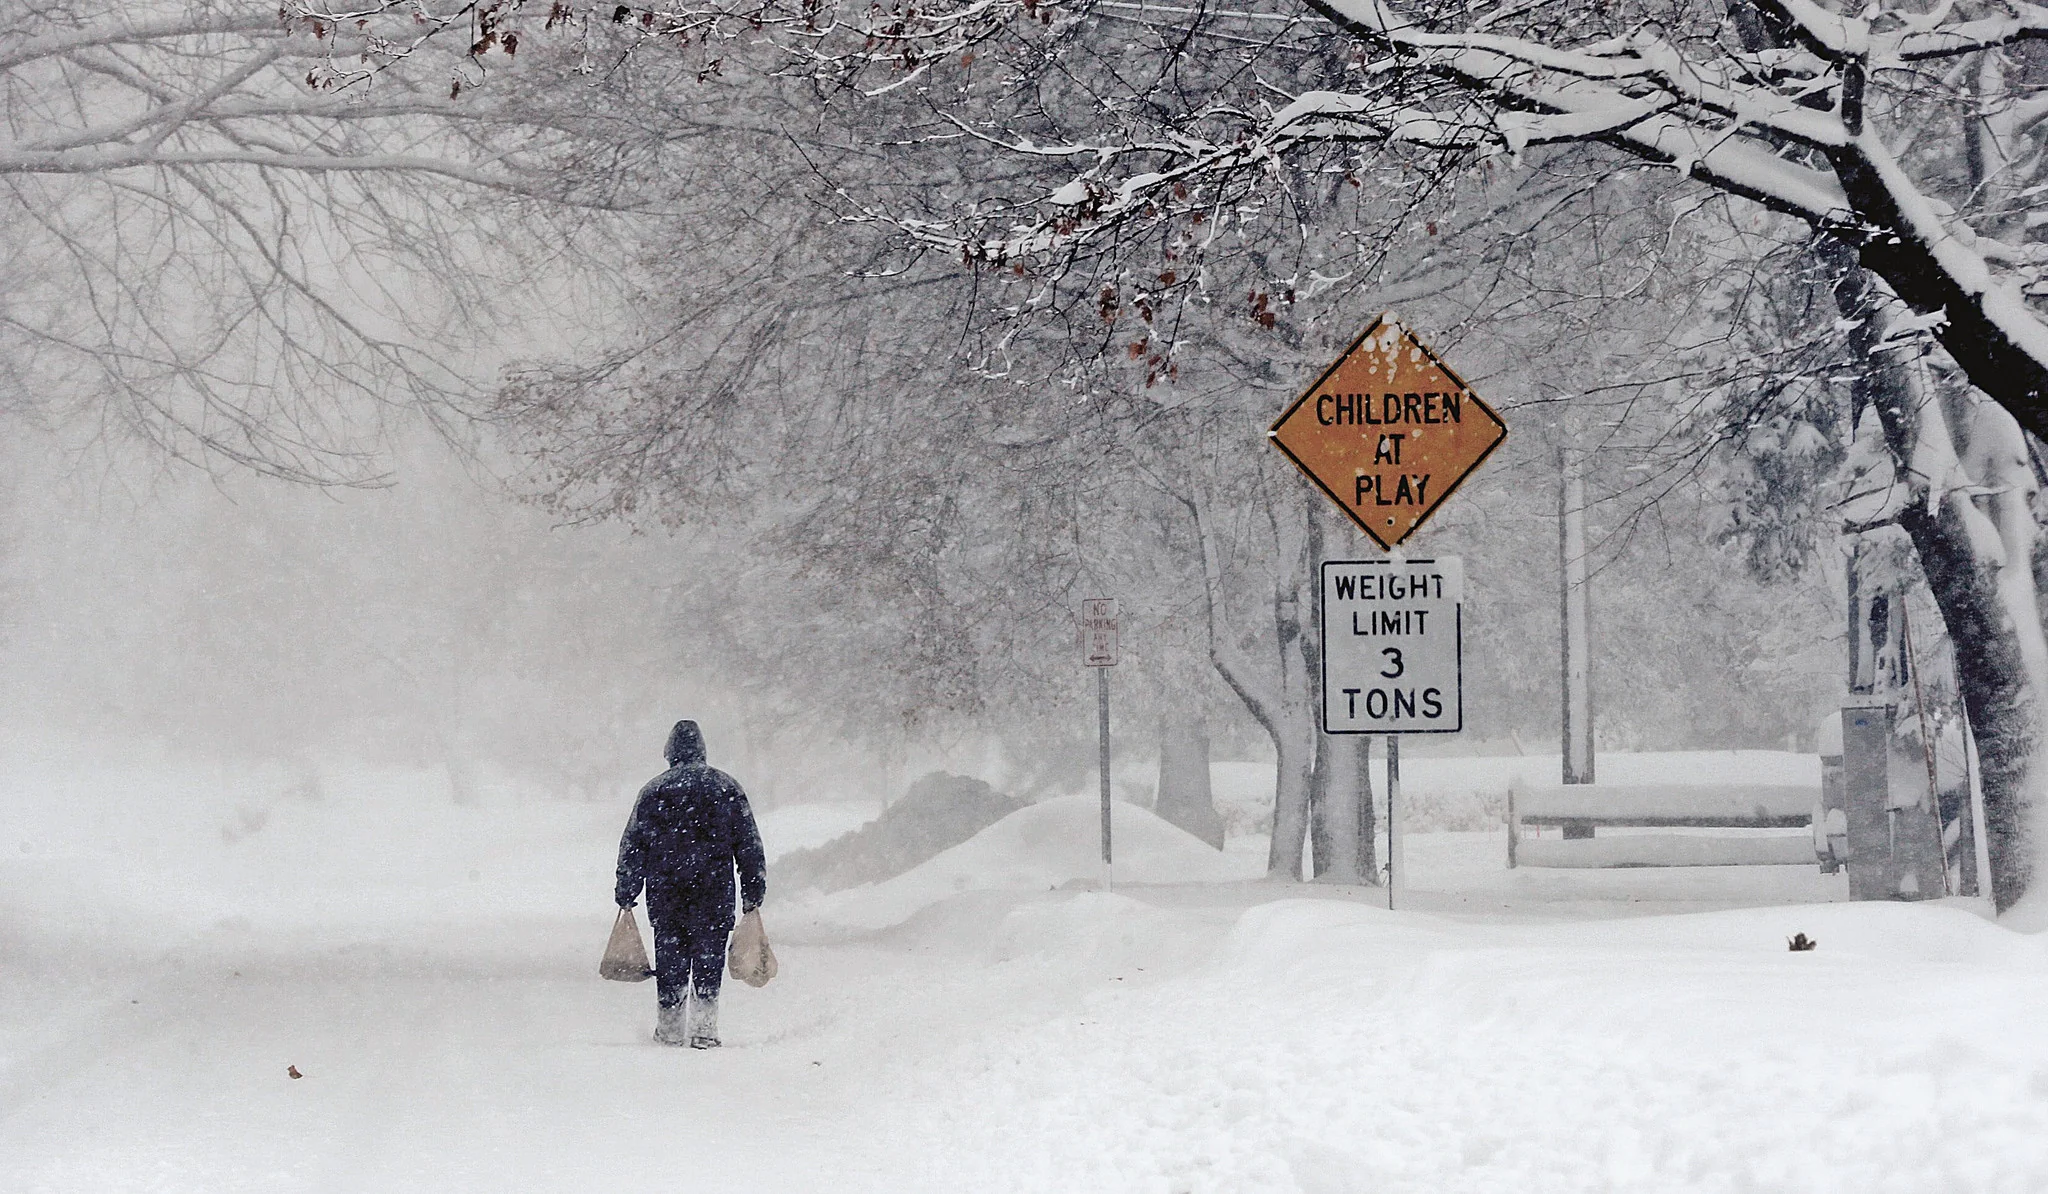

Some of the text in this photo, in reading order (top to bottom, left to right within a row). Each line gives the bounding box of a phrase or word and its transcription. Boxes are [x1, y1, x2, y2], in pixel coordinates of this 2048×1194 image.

[1316, 392, 1461, 426] CHILDREN
[1373, 433, 1405, 465] AT
[1355, 473, 1431, 506] PLAY
[1335, 574, 1444, 600] WEIGHT
[1085, 618, 1116, 631] PARKING
[1093, 602, 1107, 616] NO
[1352, 610, 1429, 636] LIMIT
[1380, 647, 1405, 679] 3
[1342, 687, 1443, 719] TONS
